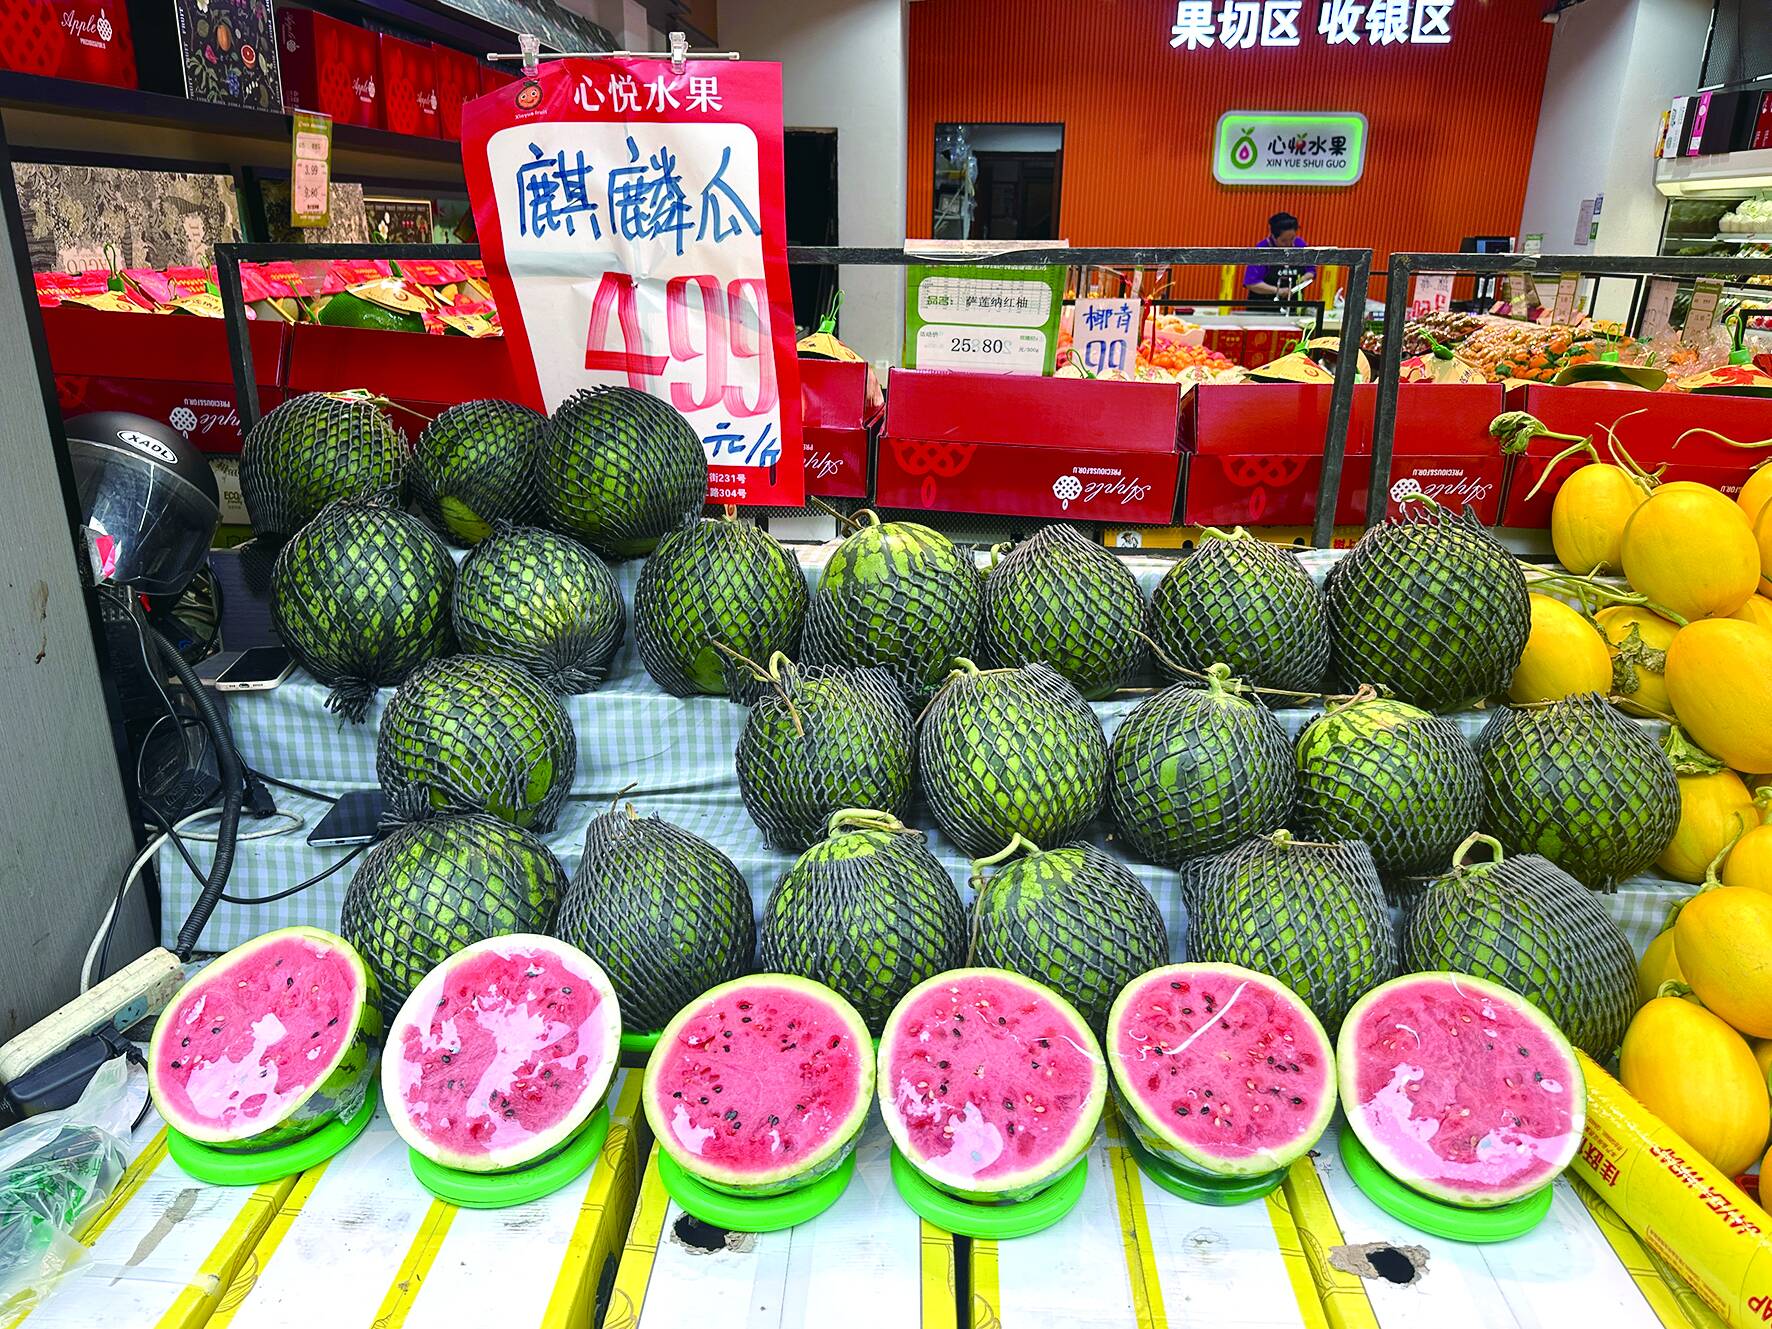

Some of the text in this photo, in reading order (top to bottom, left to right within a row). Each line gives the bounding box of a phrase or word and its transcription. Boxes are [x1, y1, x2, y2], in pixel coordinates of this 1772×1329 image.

[61, 9, 97, 37] Apple
[1170, 0, 1452, 50] 果切区 收银区
[573, 73, 723, 113] 心悦水果
[1267, 134, 1347, 156] 心悦水果
[1266, 158, 1347, 169] XIN YUE SHUI GUO
[516, 135, 763, 257] 麒麟瓜
[1082, 303, 1133, 333] 椰青
[951, 337, 1003, 354] 25.80
[128, 433, 169, 459] XADL
[707, 473, 747, 484] 街231号
[1083, 477, 1152, 505] Apple
[1423, 476, 1493, 505] Apple
[705, 487, 747, 499] 路304号
[1698, 1186, 1761, 1235] JAYEA
